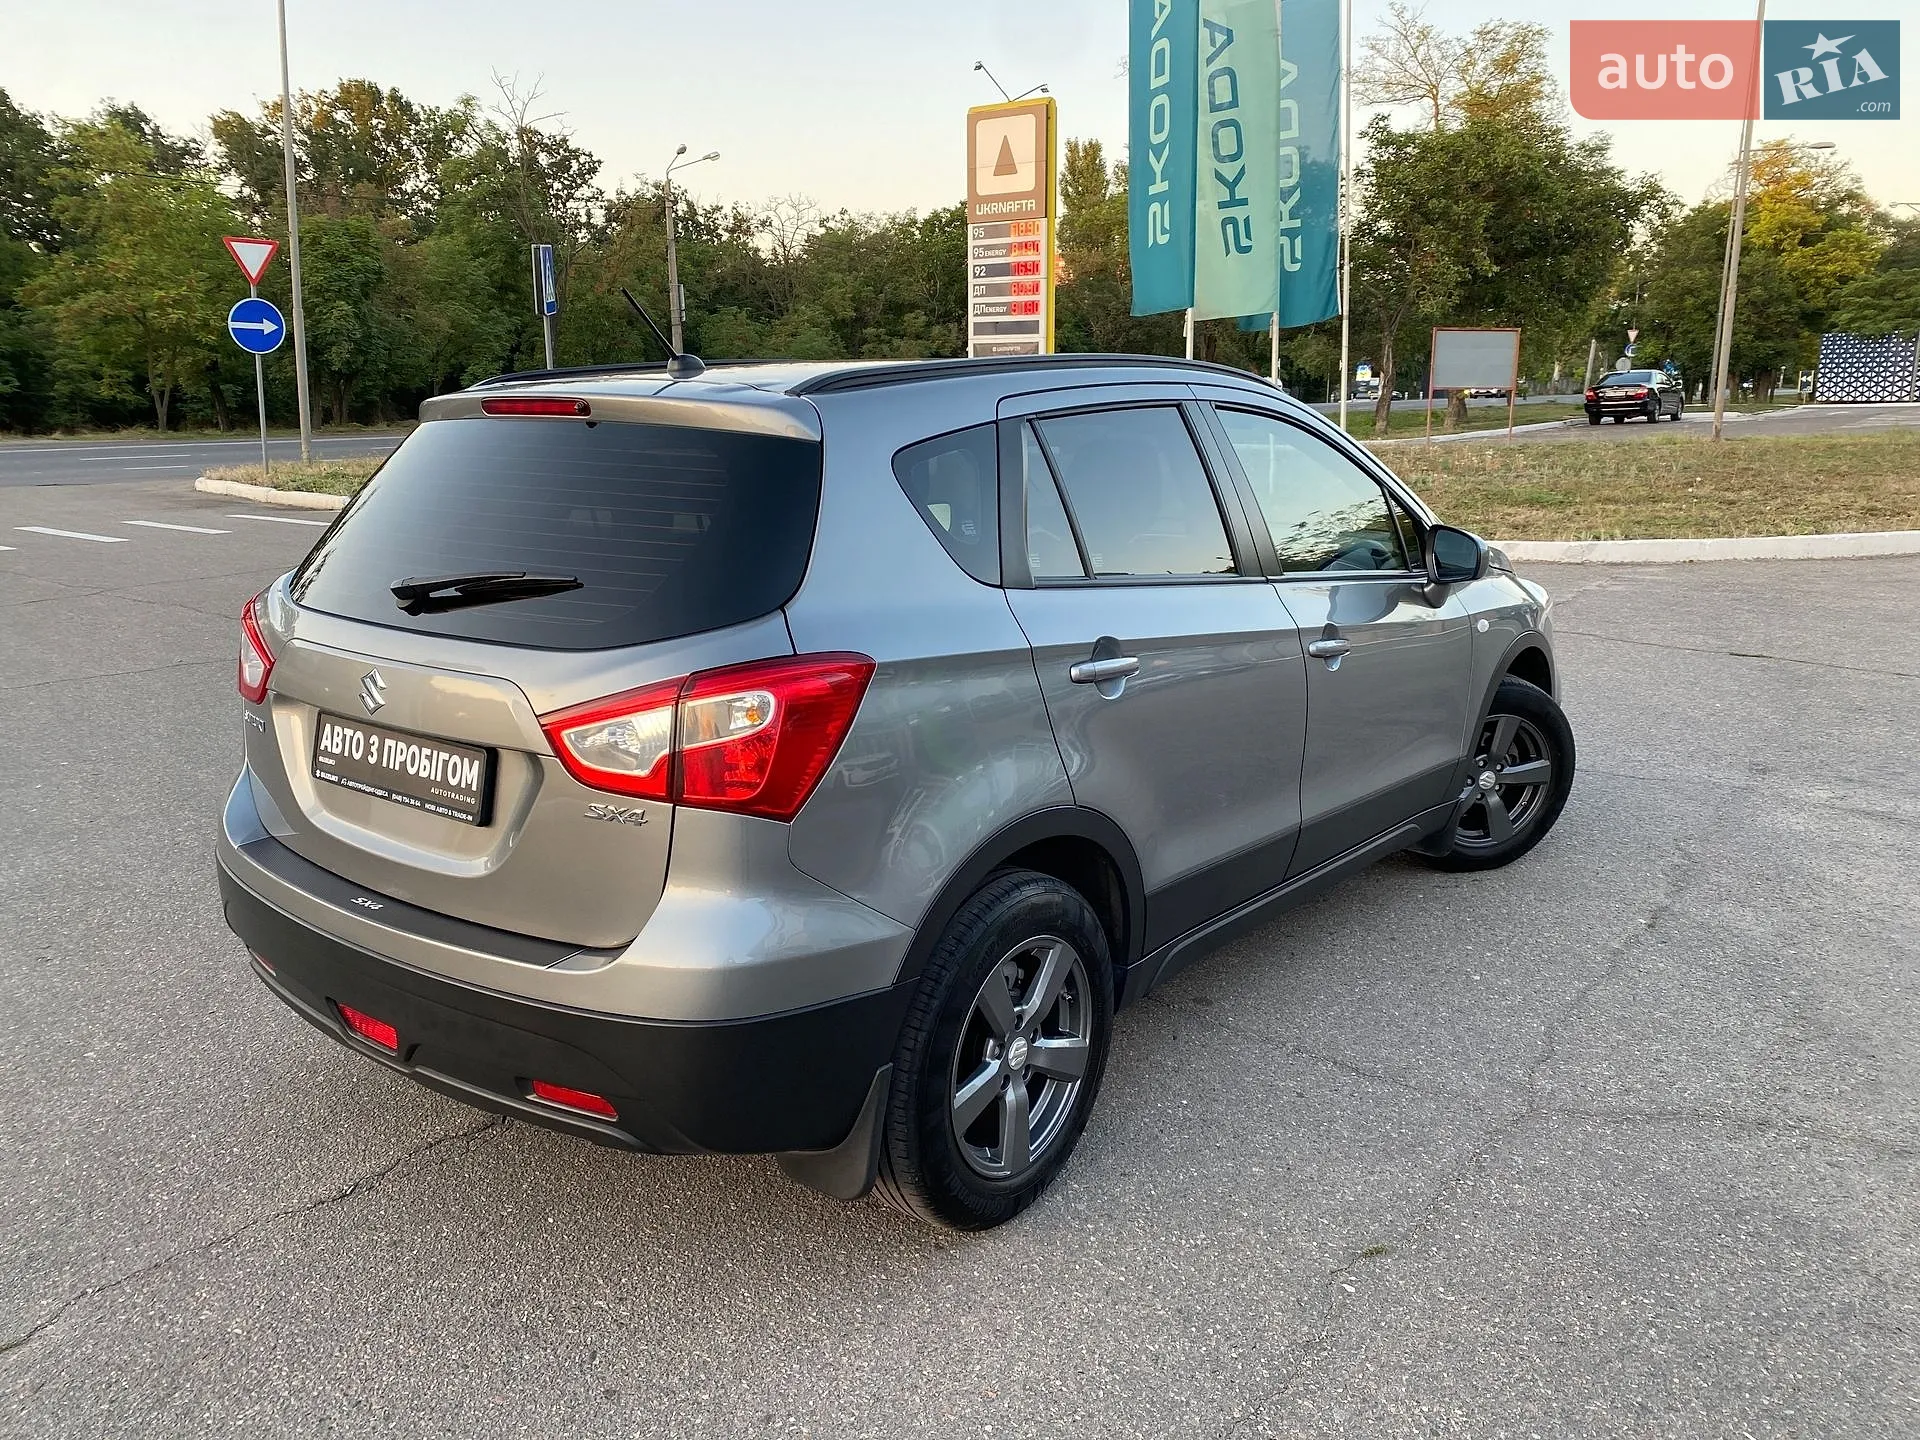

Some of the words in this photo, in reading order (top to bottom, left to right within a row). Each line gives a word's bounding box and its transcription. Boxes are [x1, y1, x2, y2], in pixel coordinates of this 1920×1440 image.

[976, 199, 1036, 215] UKRNAFTA
[973, 227, 984, 238] 95
[974, 266, 986, 276] 92
[973, 285, 986, 296] ДП
[320, 723, 364, 760] АВТО
[382, 738, 479, 791] ПРОБІГОМ
[430, 787, 476, 804] AUTOTRADING
[584, 803, 648, 826] SX4
[350, 897, 384, 910] SX4
